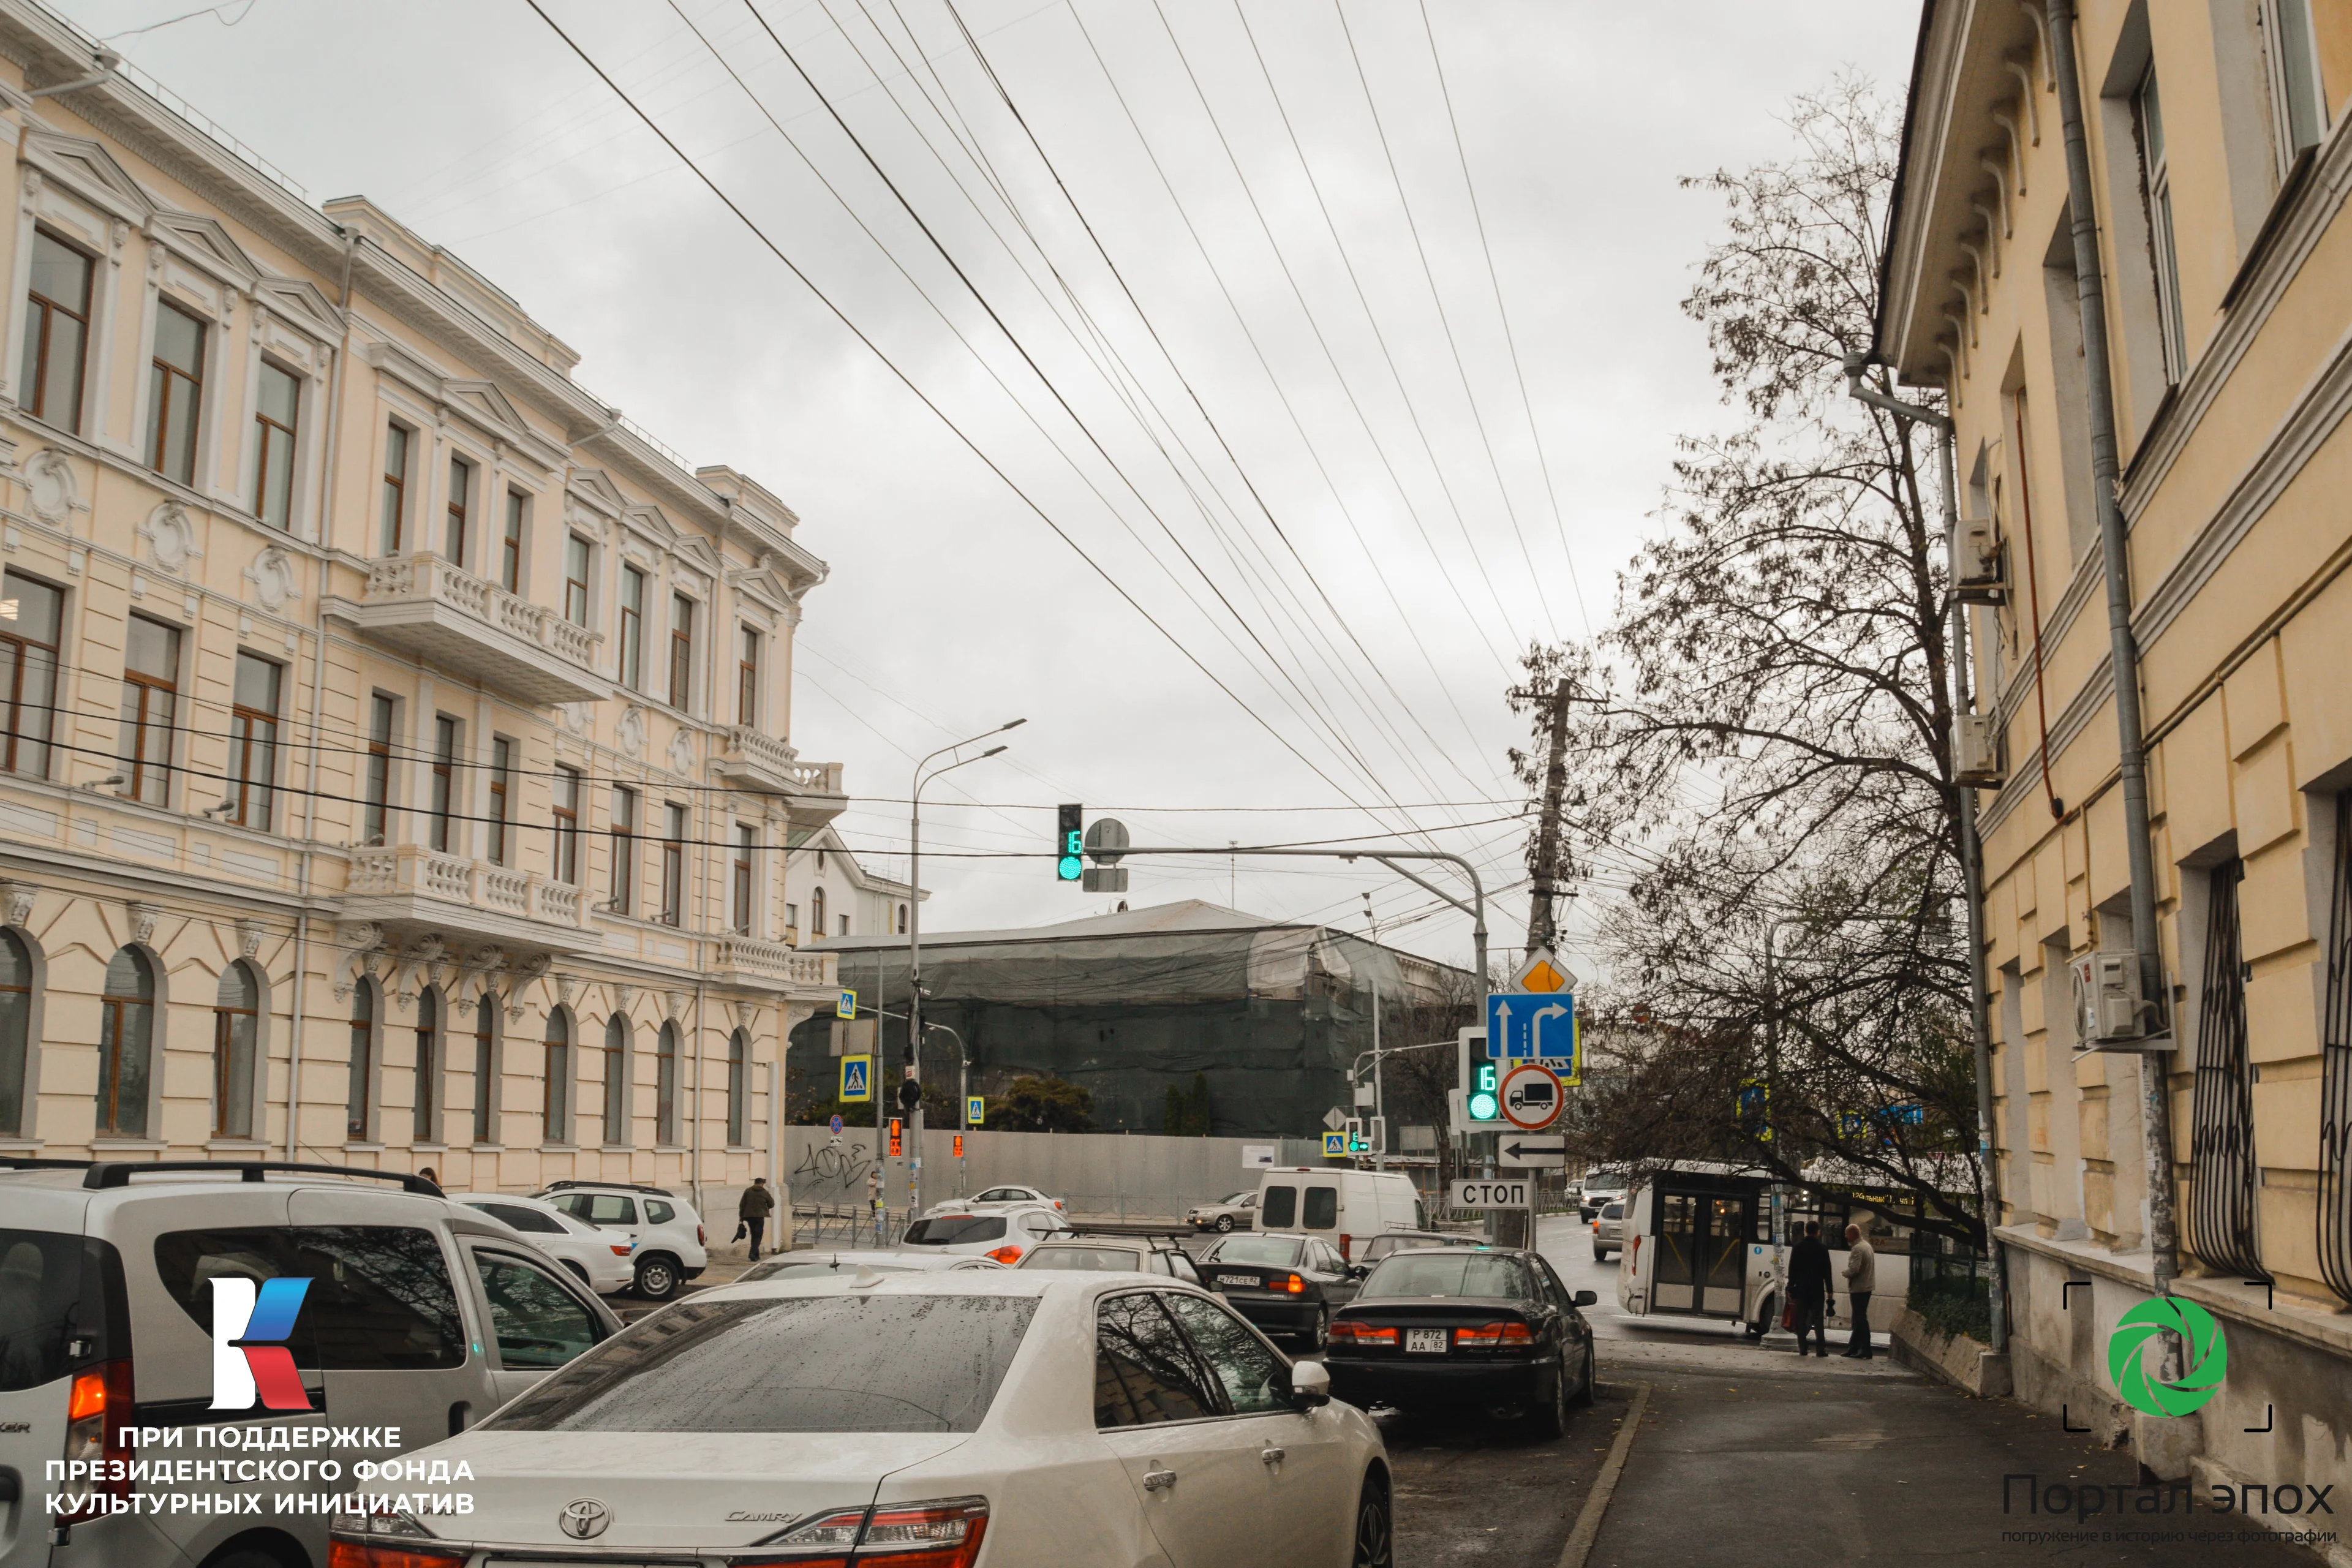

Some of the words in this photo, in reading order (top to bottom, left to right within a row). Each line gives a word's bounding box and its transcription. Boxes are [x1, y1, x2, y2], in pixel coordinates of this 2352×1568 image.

[1480, 1066, 1496, 1090] 16
[1463, 1185, 1523, 1204] СТОП
[1423, 1330, 1441, 1340] 872
[1411, 1342, 1425, 1351] АА
